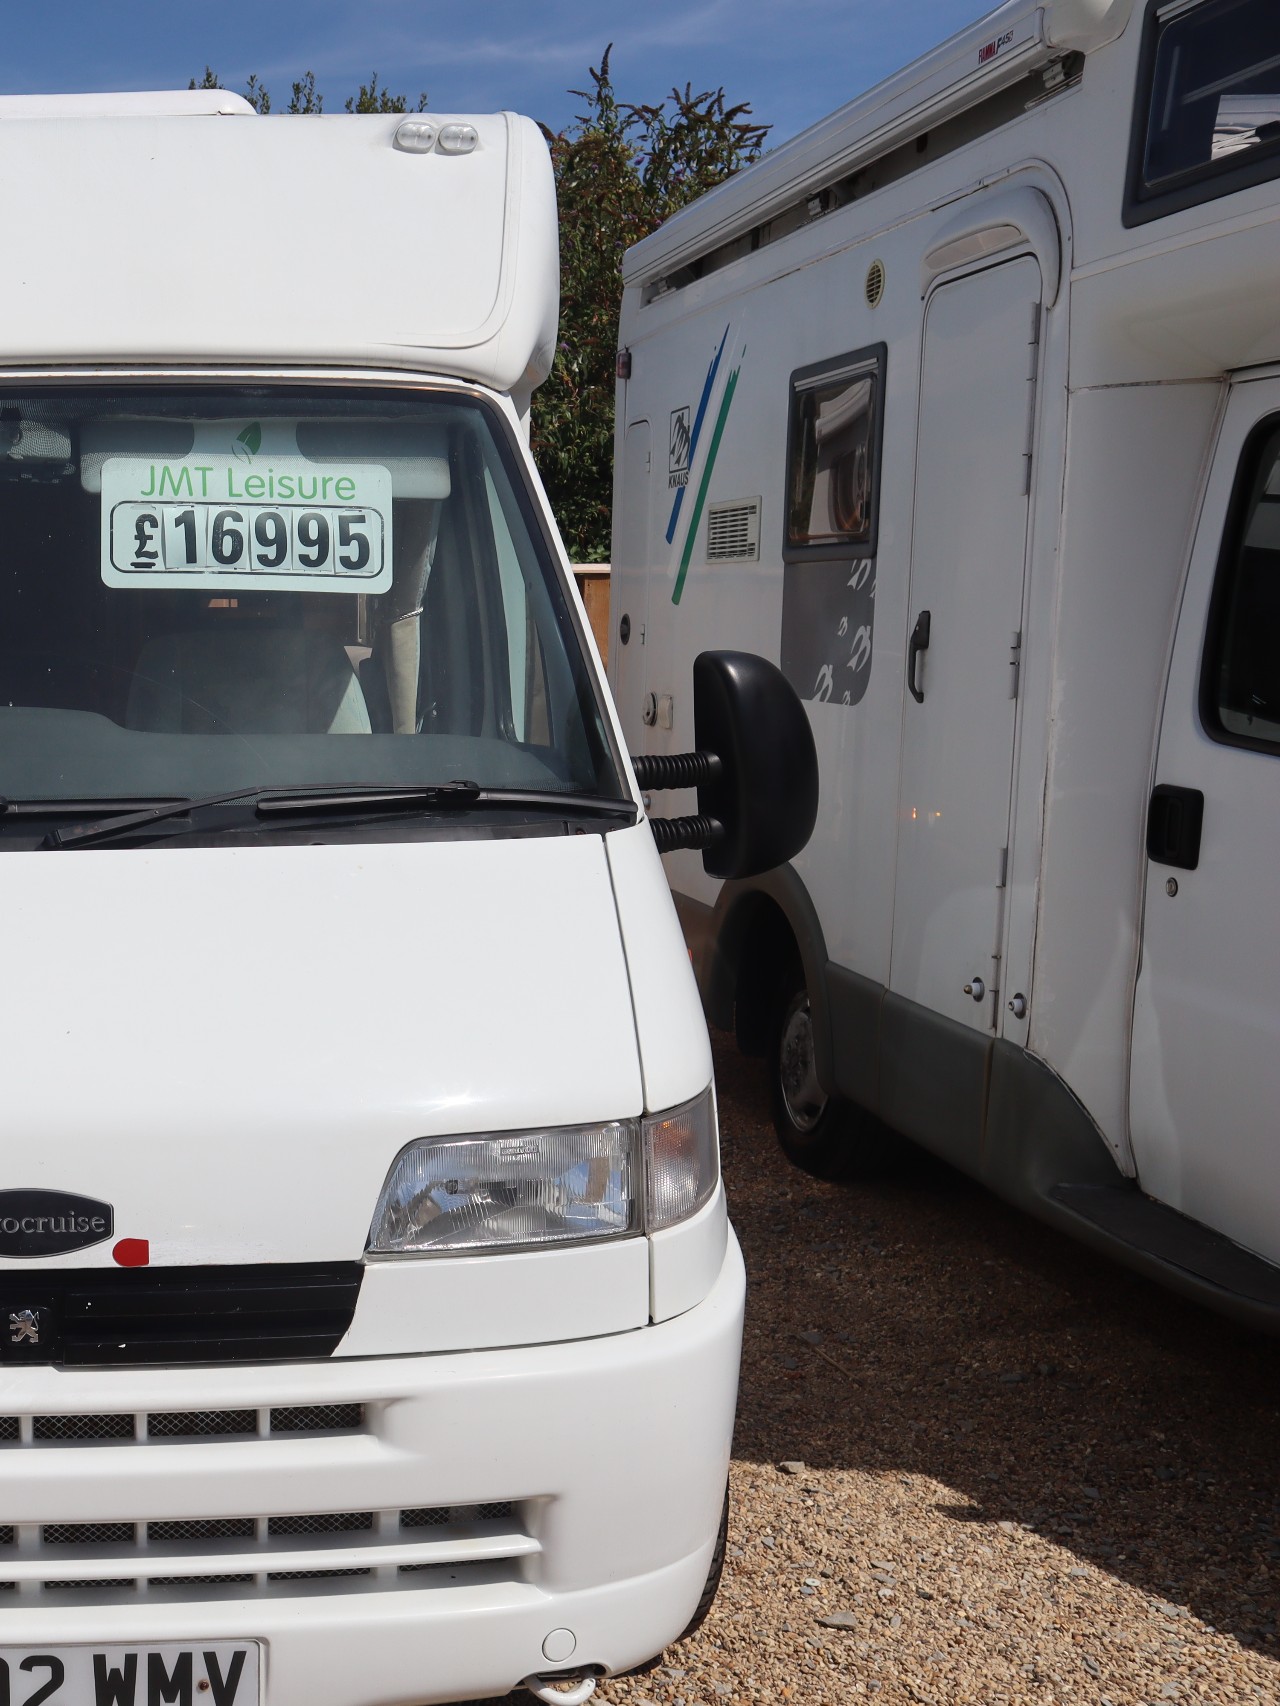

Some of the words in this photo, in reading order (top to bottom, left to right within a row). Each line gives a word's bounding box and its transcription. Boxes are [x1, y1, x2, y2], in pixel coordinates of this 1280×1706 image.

[141, 464, 213, 497] JMT
[227, 467, 356, 500] Leisure
[668, 471, 689, 489] KNAUS
[130, 508, 370, 571] £16995
[92, 1650, 248, 1706] WMV
